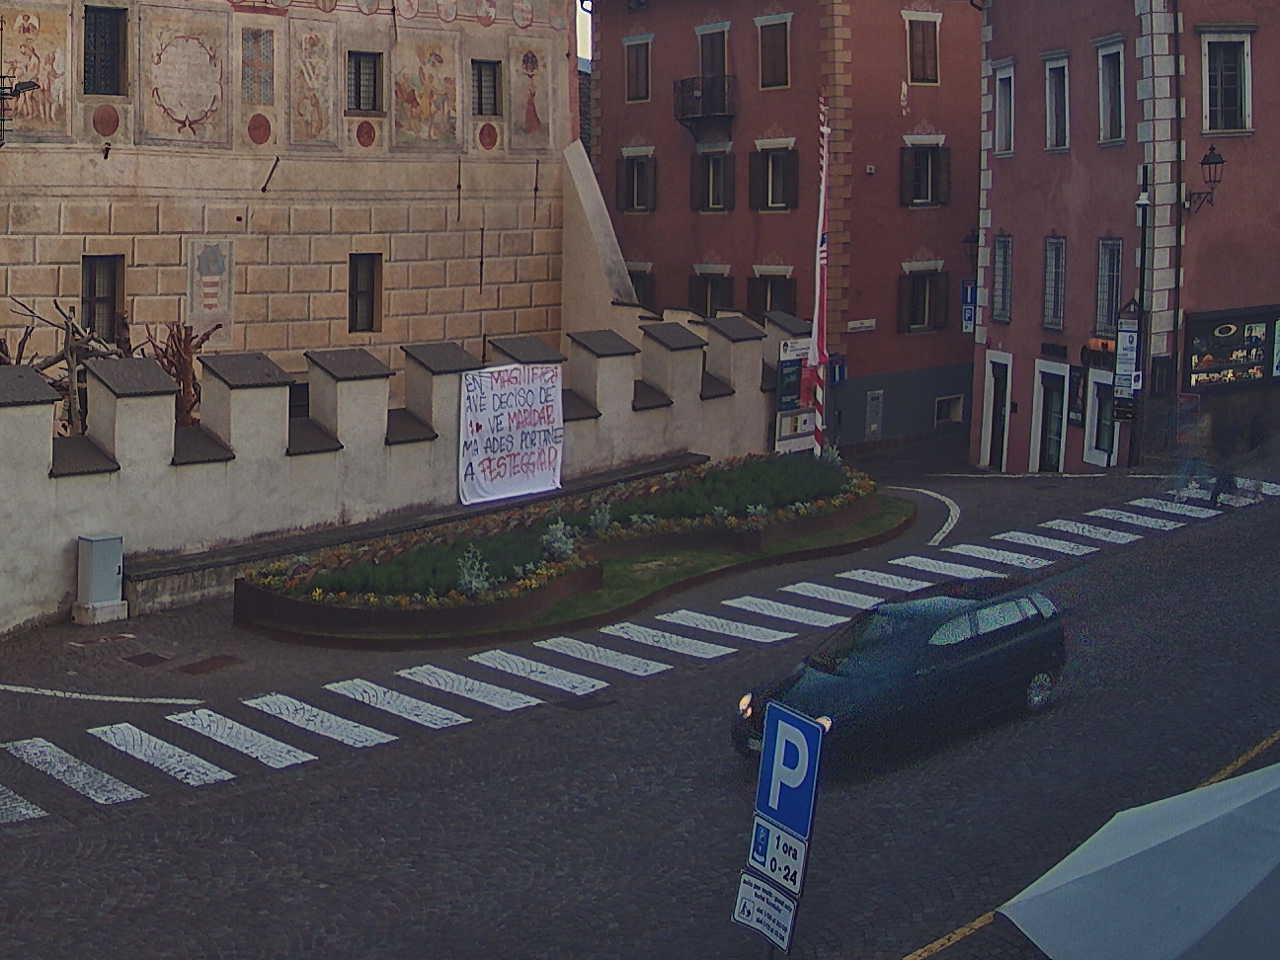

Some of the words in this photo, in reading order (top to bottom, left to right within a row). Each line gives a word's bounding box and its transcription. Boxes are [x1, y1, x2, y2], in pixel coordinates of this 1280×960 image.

[493, 387, 534, 412] DECISO
[463, 438, 479, 457] MA
[483, 434, 514, 454] ADES
[464, 462, 475, 482] A
[768, 720, 809, 810] P
[782, 842, 798, 860] ora
